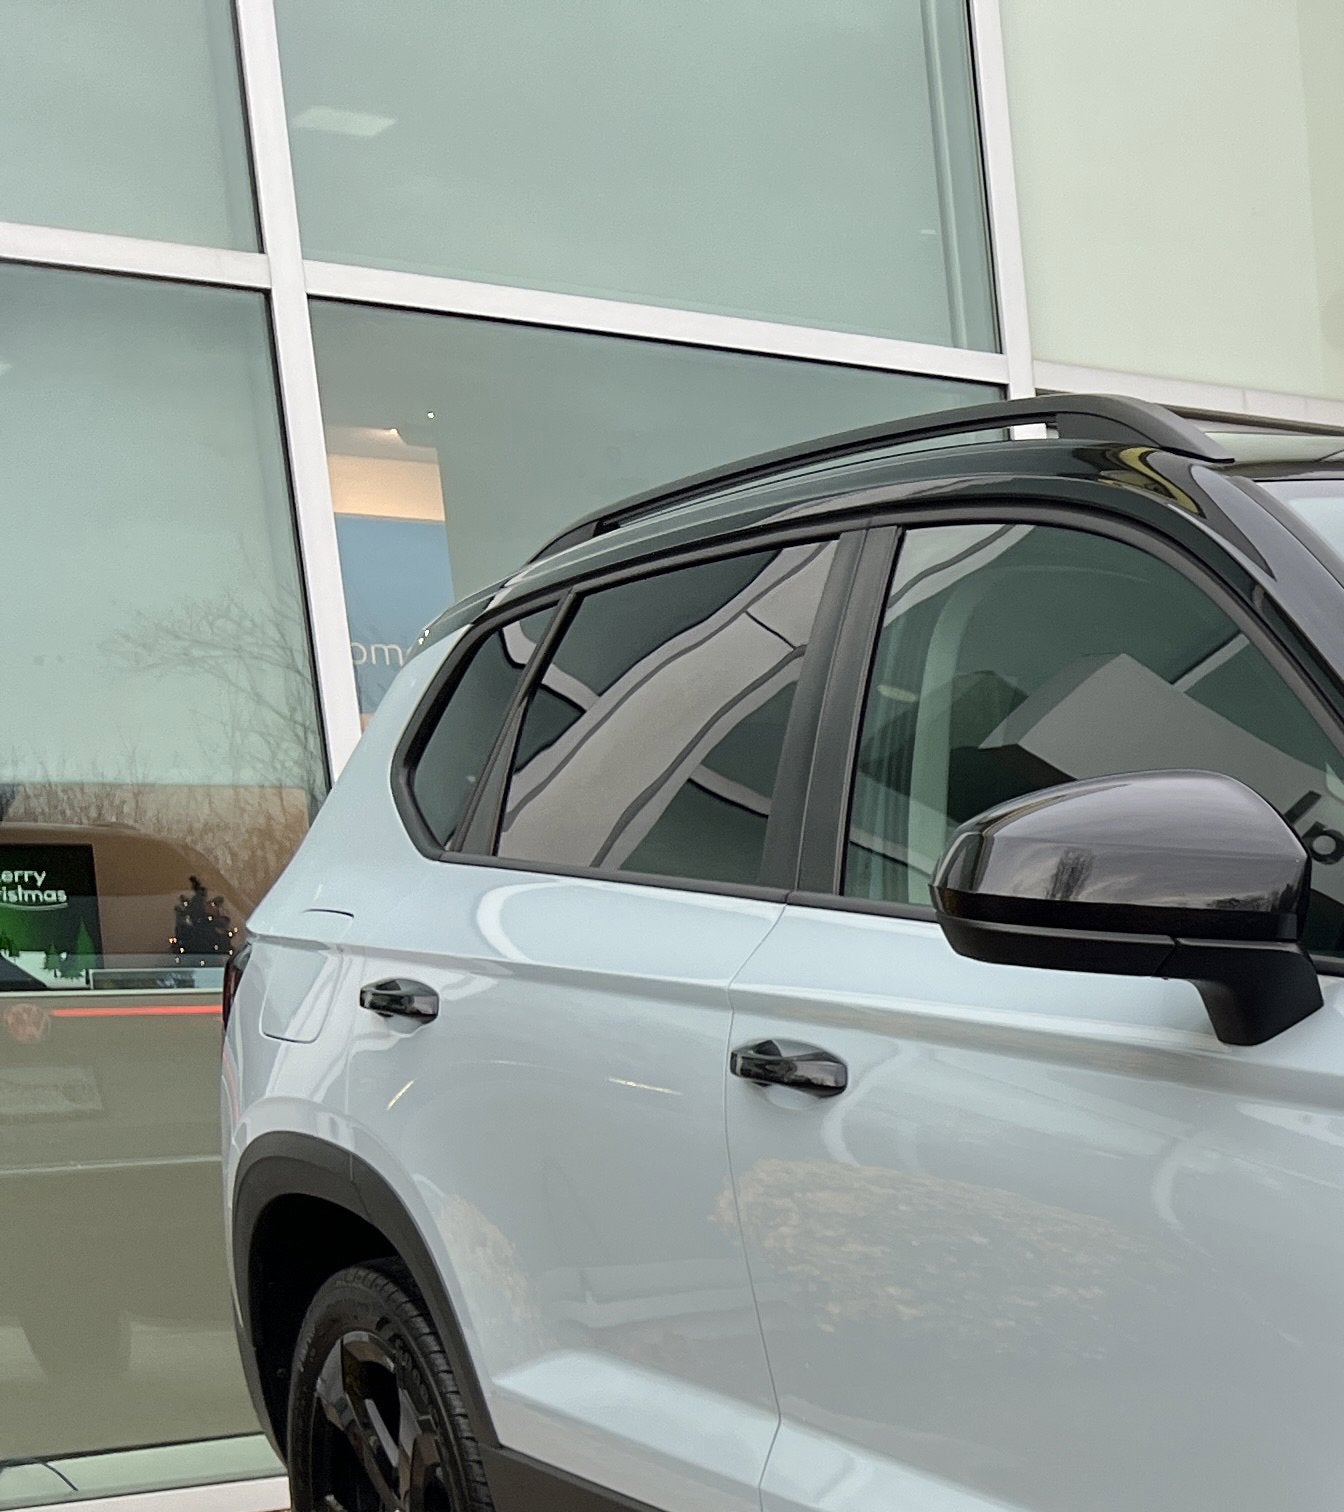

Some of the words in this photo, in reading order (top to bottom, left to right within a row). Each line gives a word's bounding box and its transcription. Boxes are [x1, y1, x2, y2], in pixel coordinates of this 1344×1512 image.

[351, 641, 404, 667] om
[0, 870, 47, 888] erry
[0, 884, 68, 904] istmas
